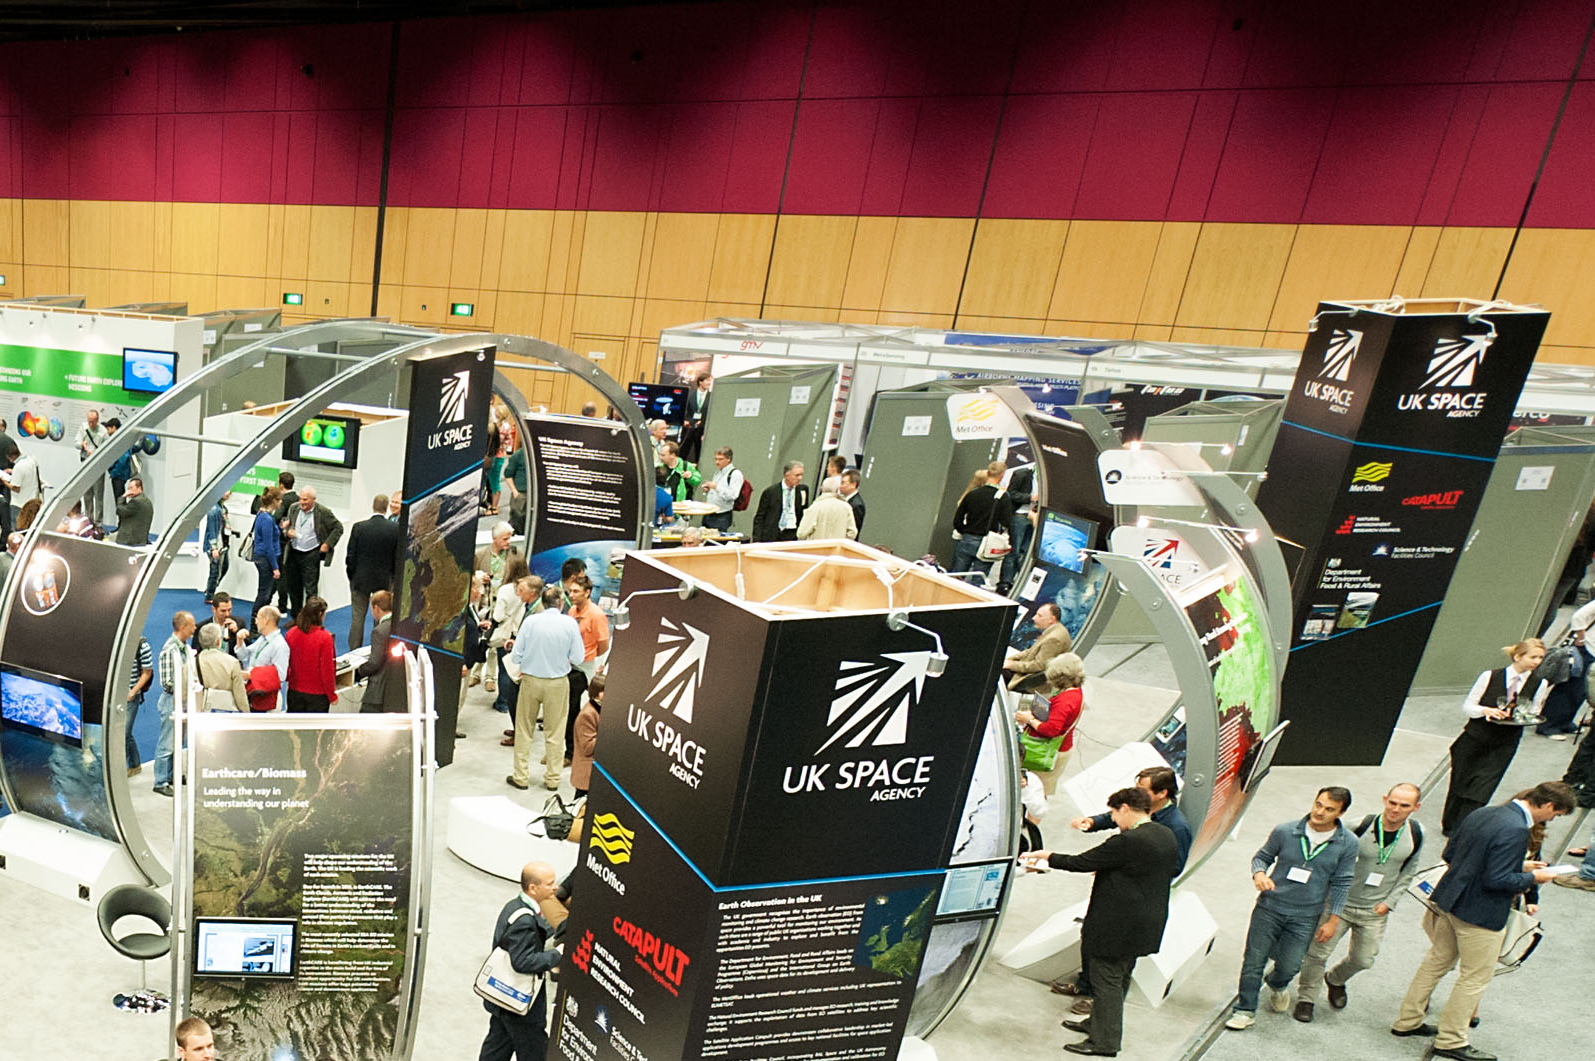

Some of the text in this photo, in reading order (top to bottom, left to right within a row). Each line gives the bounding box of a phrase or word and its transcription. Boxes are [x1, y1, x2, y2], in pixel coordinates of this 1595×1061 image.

[740, 340, 765, 351] gmv
[1304, 380, 1355, 407] UK SPACE
[1397, 393, 1487, 411] UK SPACE
[1329, 404, 1349, 415] AGENCY
[1446, 409, 1481, 418] AGENCY
[428, 424, 473, 449] UK SPACE
[1401, 490, 1464, 506] CATAPULT
[1324, 568, 1362, 577] Department
[627, 703, 707, 777] UK SPACE
[202, 767, 307, 778] Earthcare/Biomass
[668, 762, 701, 790] AGENCY
[782, 755, 935, 794] UK SPACE
[203, 787, 281, 798] Leading the way in
[869, 786, 927, 802] AGENCY
[203, 799, 264, 810] understanding
[281, 799, 310, 810] planet
[586, 853, 626, 896] Met Office
[718, 894, 823, 910] Earth Observation in the UK
[594, 942, 622, 972] NATURAL
[613, 916, 690, 987] CATAPULT
[592, 954, 635, 998] ENVIRONMENT
[590, 967, 646, 1025] RESEARCH COUNCIL
[561, 1026, 570, 1041] for
[563, 1013, 598, 1056] Department
[612, 1026, 632, 1051] Science
[631, 1045, 637, 1056] &
[559, 1039, 575, 1061] Food
[610, 1035, 630, 1061] Facilities
